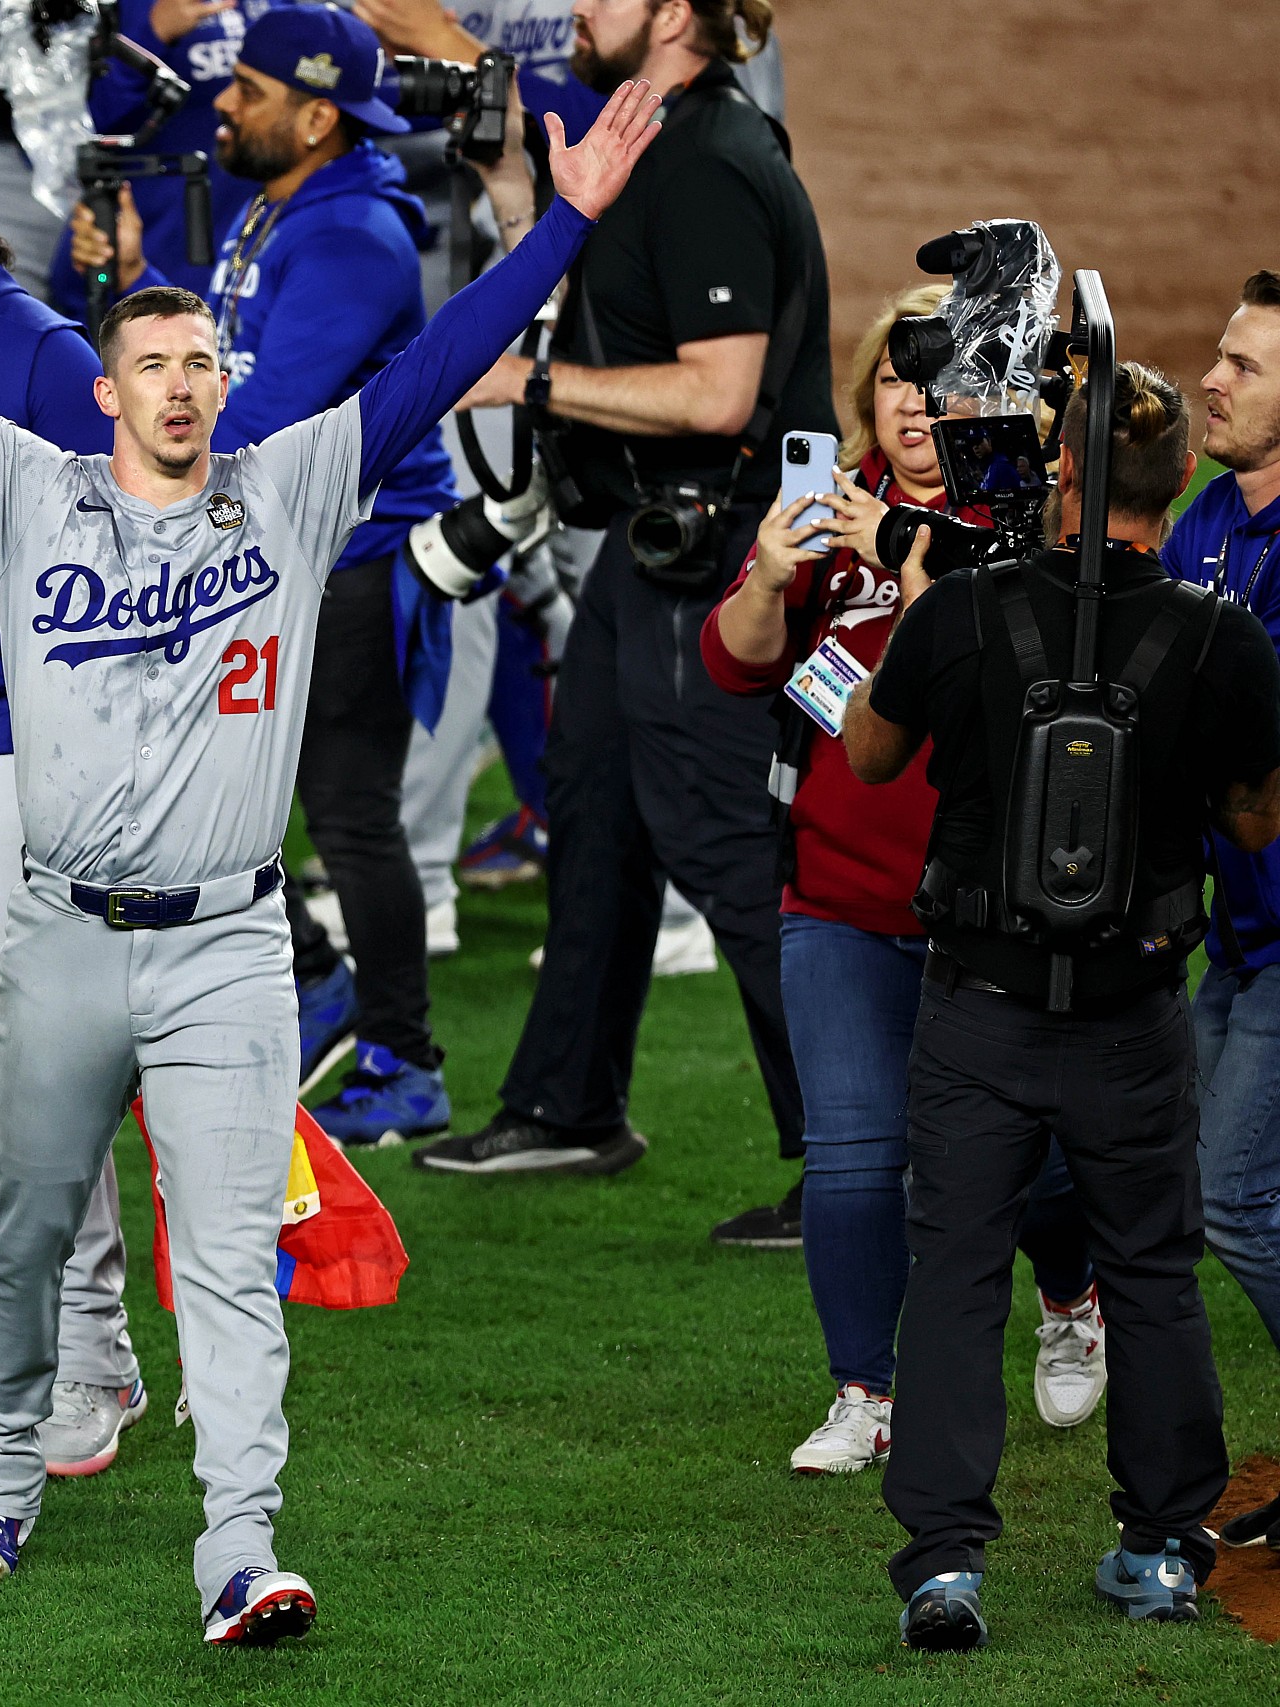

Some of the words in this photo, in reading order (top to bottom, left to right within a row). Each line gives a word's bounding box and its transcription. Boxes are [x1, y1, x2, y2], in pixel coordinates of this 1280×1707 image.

[209, 504, 241, 519] WORLD
[214, 510, 244, 524] SERIES
[32, 546, 279, 665] Dodgers
[218, 635, 279, 715] 21
